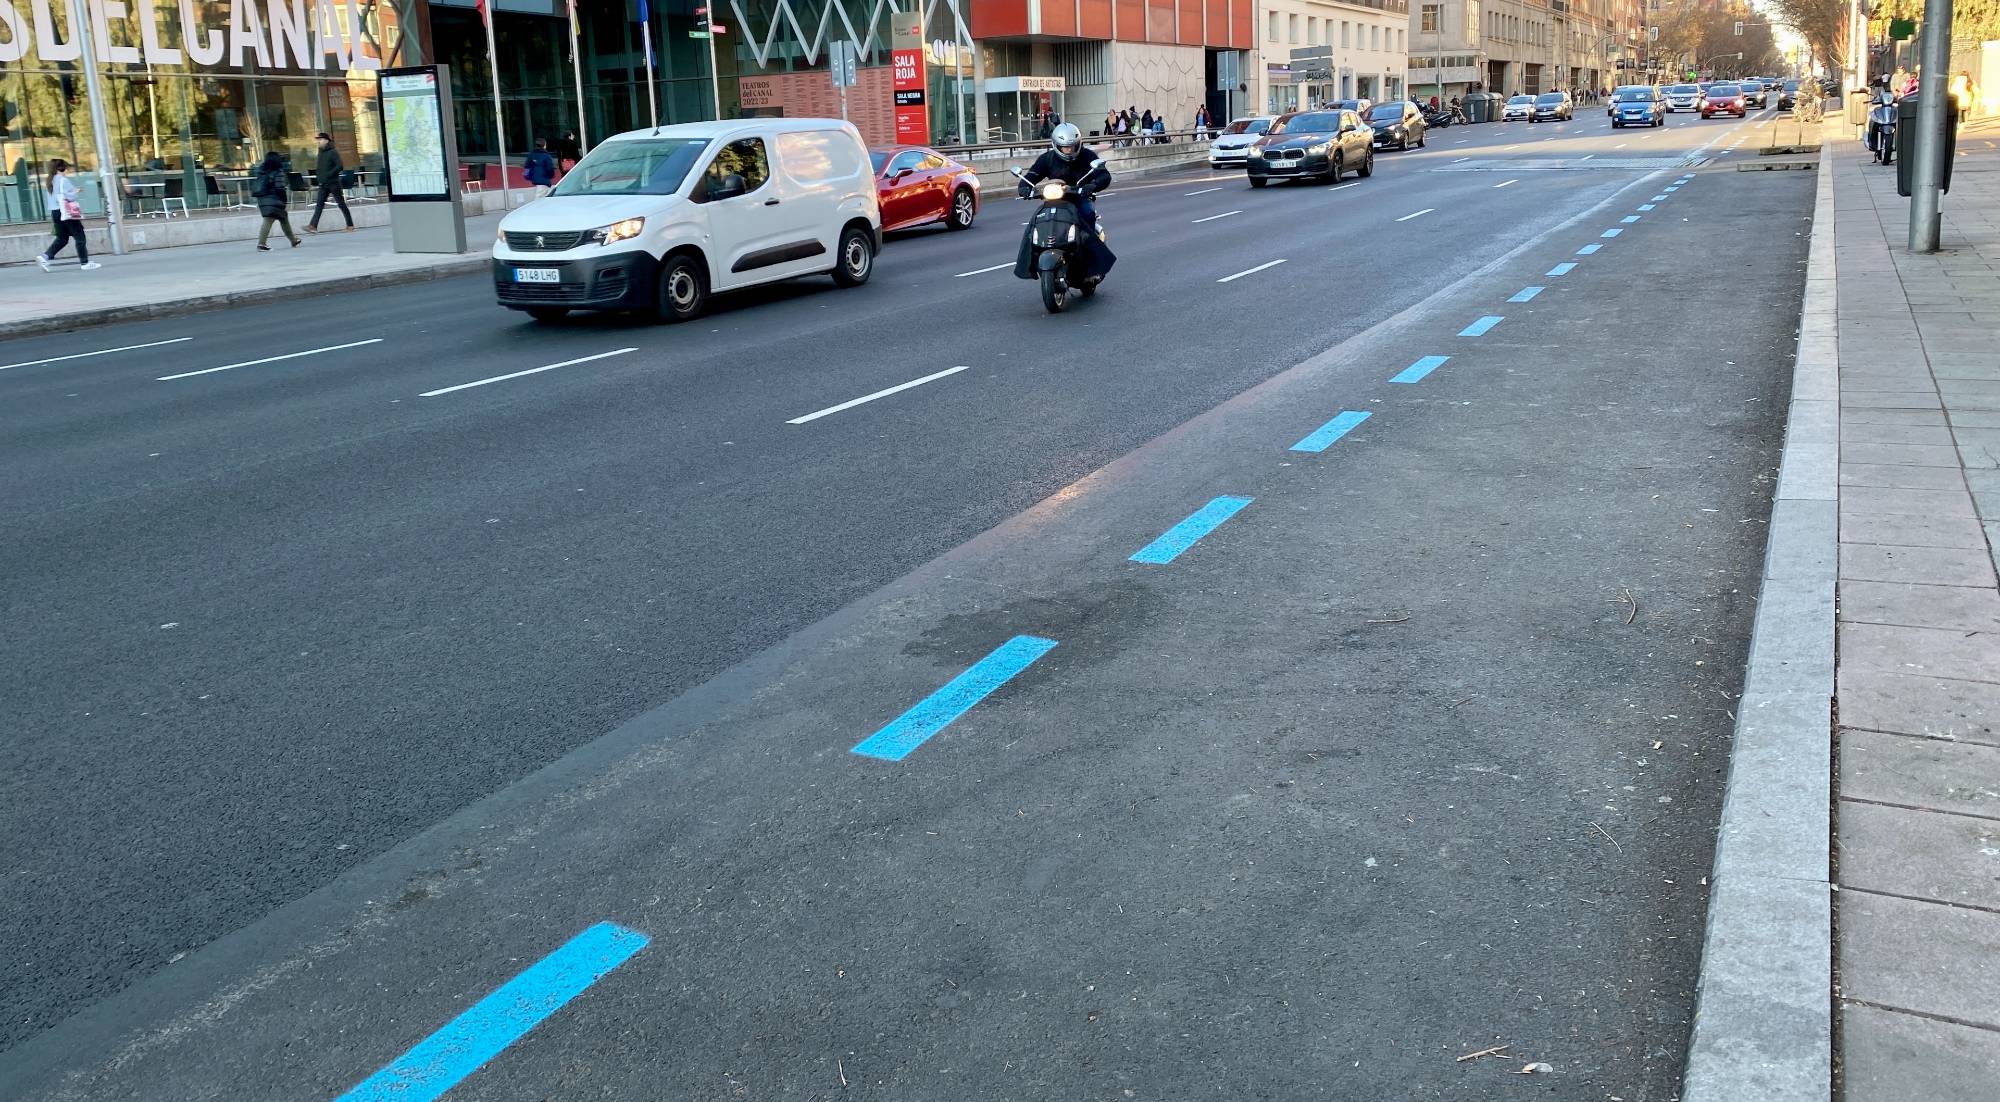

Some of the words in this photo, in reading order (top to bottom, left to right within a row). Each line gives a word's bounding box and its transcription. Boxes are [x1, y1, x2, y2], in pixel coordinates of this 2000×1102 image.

[894, 55, 916, 67] SALA
[895, 67, 917, 80] ROJA
[742, 81, 770, 89] TEATROS
[1022, 79, 1039, 88] ENTRADA
[1040, 79, 1045, 88] DE
[1045, 79, 1061, 88] ARTISTAS
[742, 89, 752, 98] del
[753, 88, 774, 97] CANAL
[743, 97, 769, 106] 2022/23
[518, 270, 539, 280] 5148
[540, 270, 557, 280] LHG
